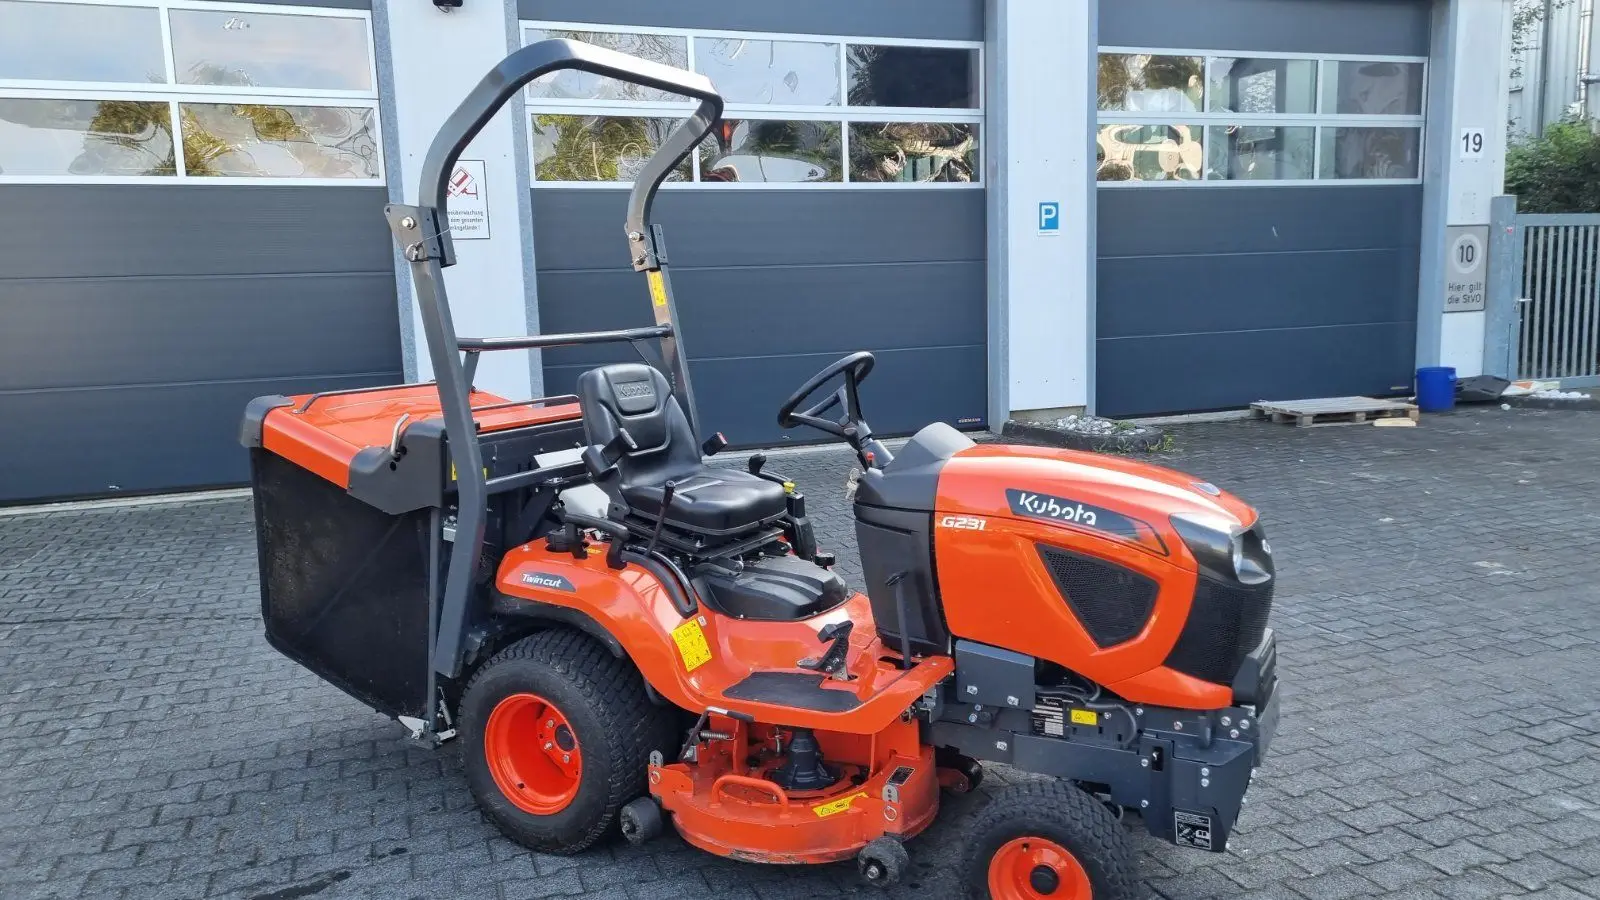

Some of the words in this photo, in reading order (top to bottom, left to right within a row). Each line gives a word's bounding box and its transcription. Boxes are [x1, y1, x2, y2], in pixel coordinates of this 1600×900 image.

[1462, 132, 1482, 153] 19
[1041, 204, 1057, 227] P
[1460, 245, 1474, 263] 10
[1448, 282, 1465, 292] Hier
[1468, 282, 1482, 293] gilt
[1447, 295, 1459, 304] die
[1462, 293, 1481, 303] StVO
[1019, 492, 1097, 526] Kubota
[941, 516, 987, 531] G231
